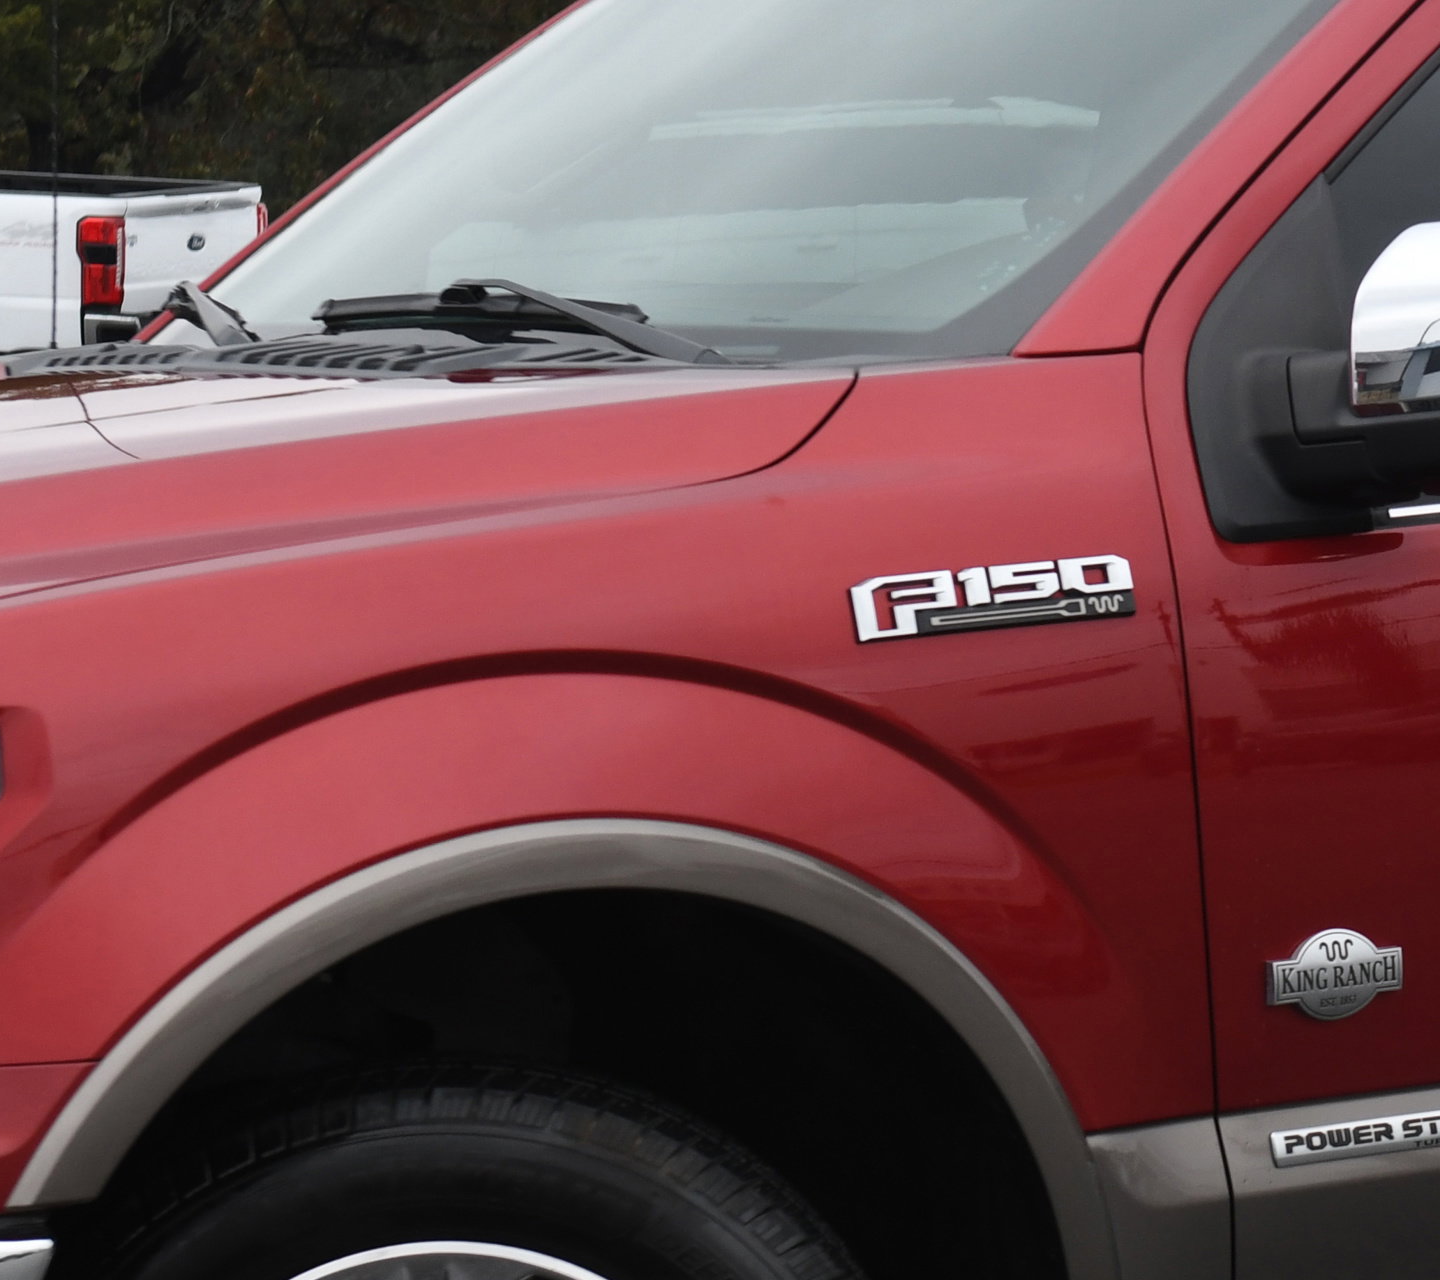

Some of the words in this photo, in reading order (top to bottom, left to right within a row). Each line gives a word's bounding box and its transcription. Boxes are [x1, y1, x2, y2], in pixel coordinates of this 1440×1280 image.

[1281, 967, 1328, 995] KING
[1333, 954, 1397, 988] RANCH
[1284, 1122, 1394, 1155] POWER
